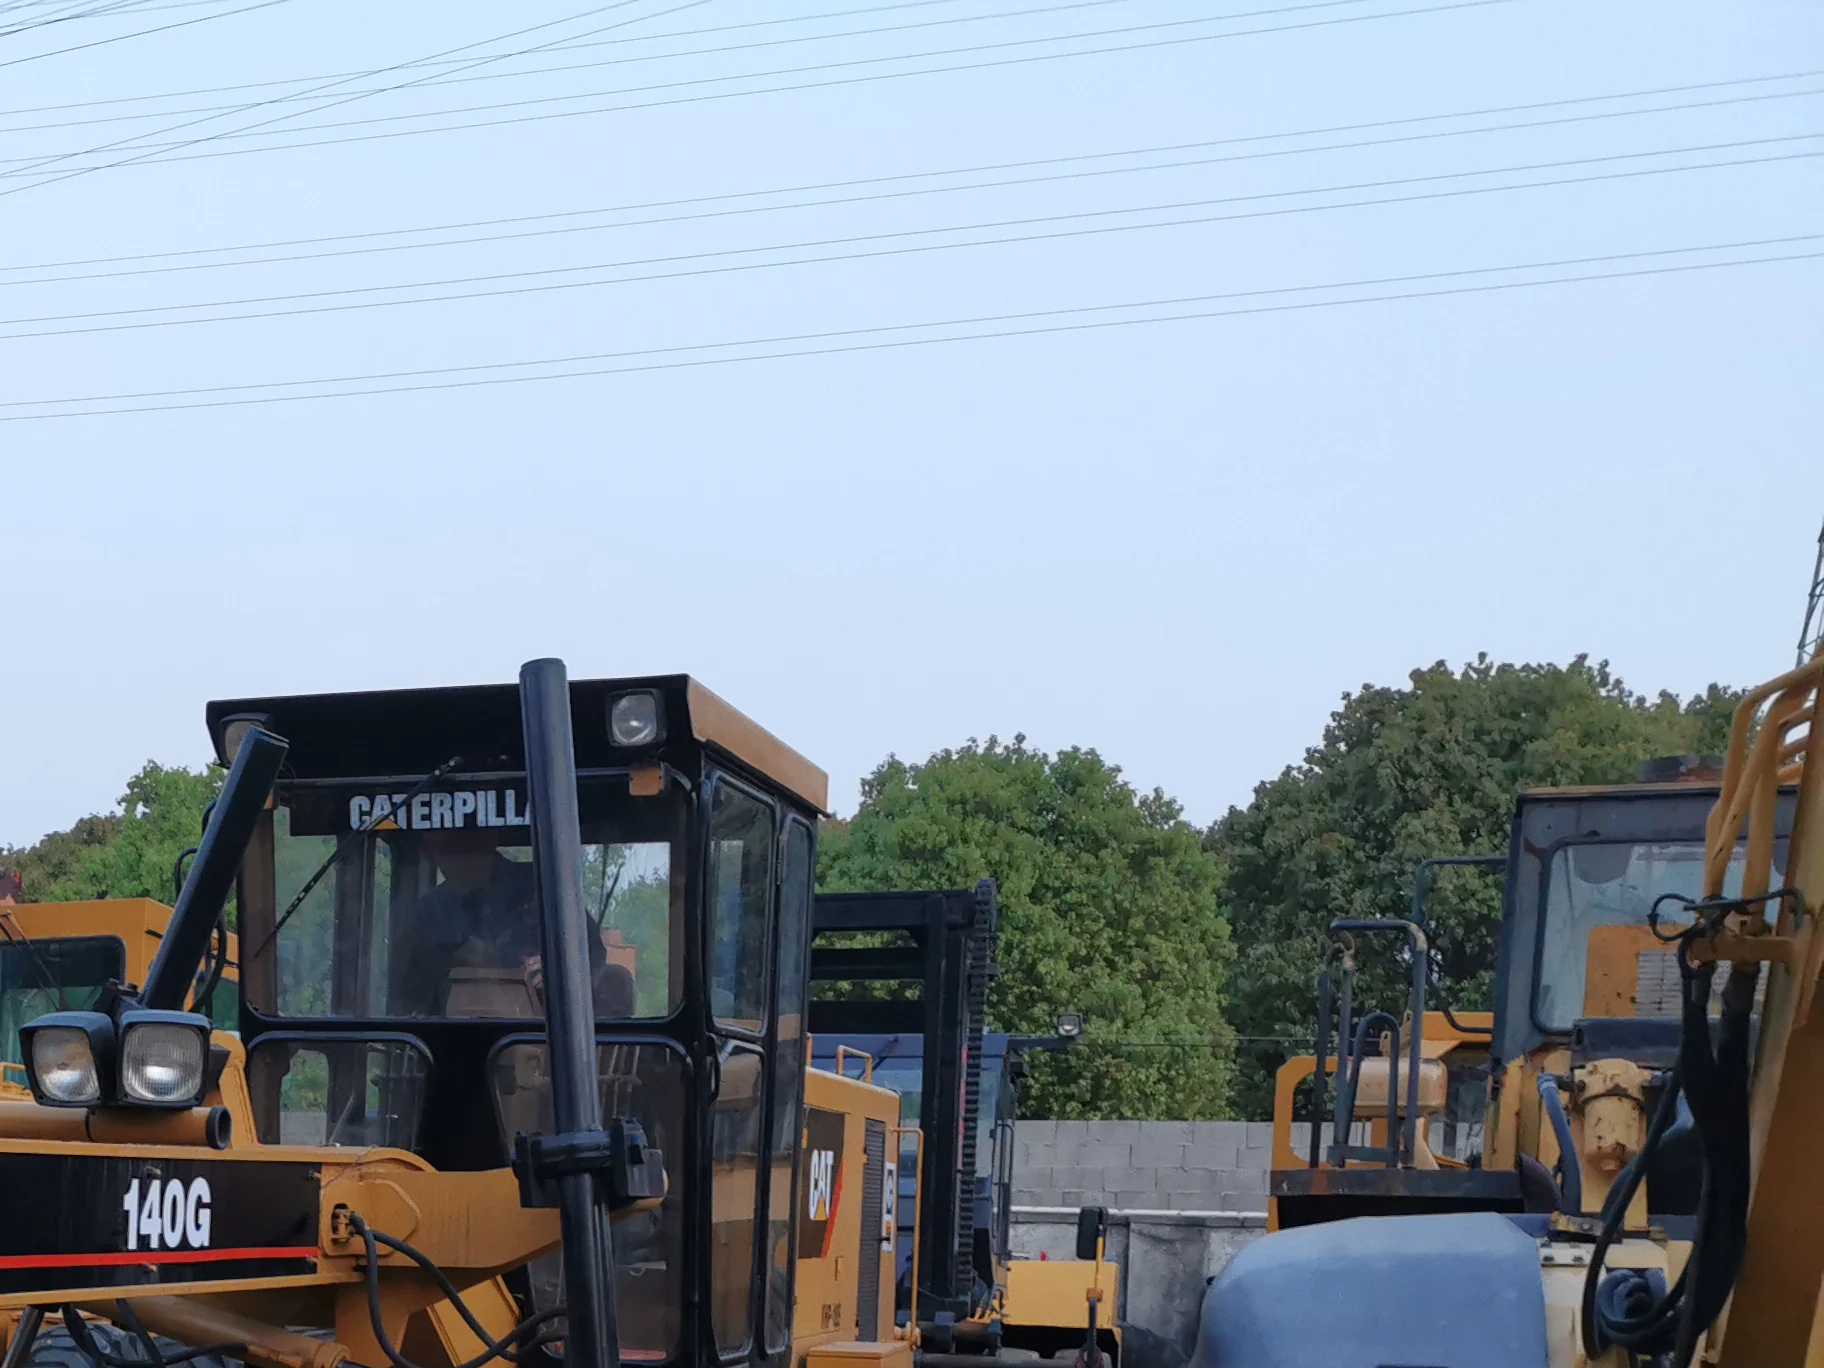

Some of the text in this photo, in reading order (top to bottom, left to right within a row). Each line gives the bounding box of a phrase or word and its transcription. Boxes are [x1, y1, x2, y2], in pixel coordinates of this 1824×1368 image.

[349, 789, 530, 832] CATERPILL
[122, 1176, 212, 1250] 140G
[809, 1150, 834, 1220] CAT
